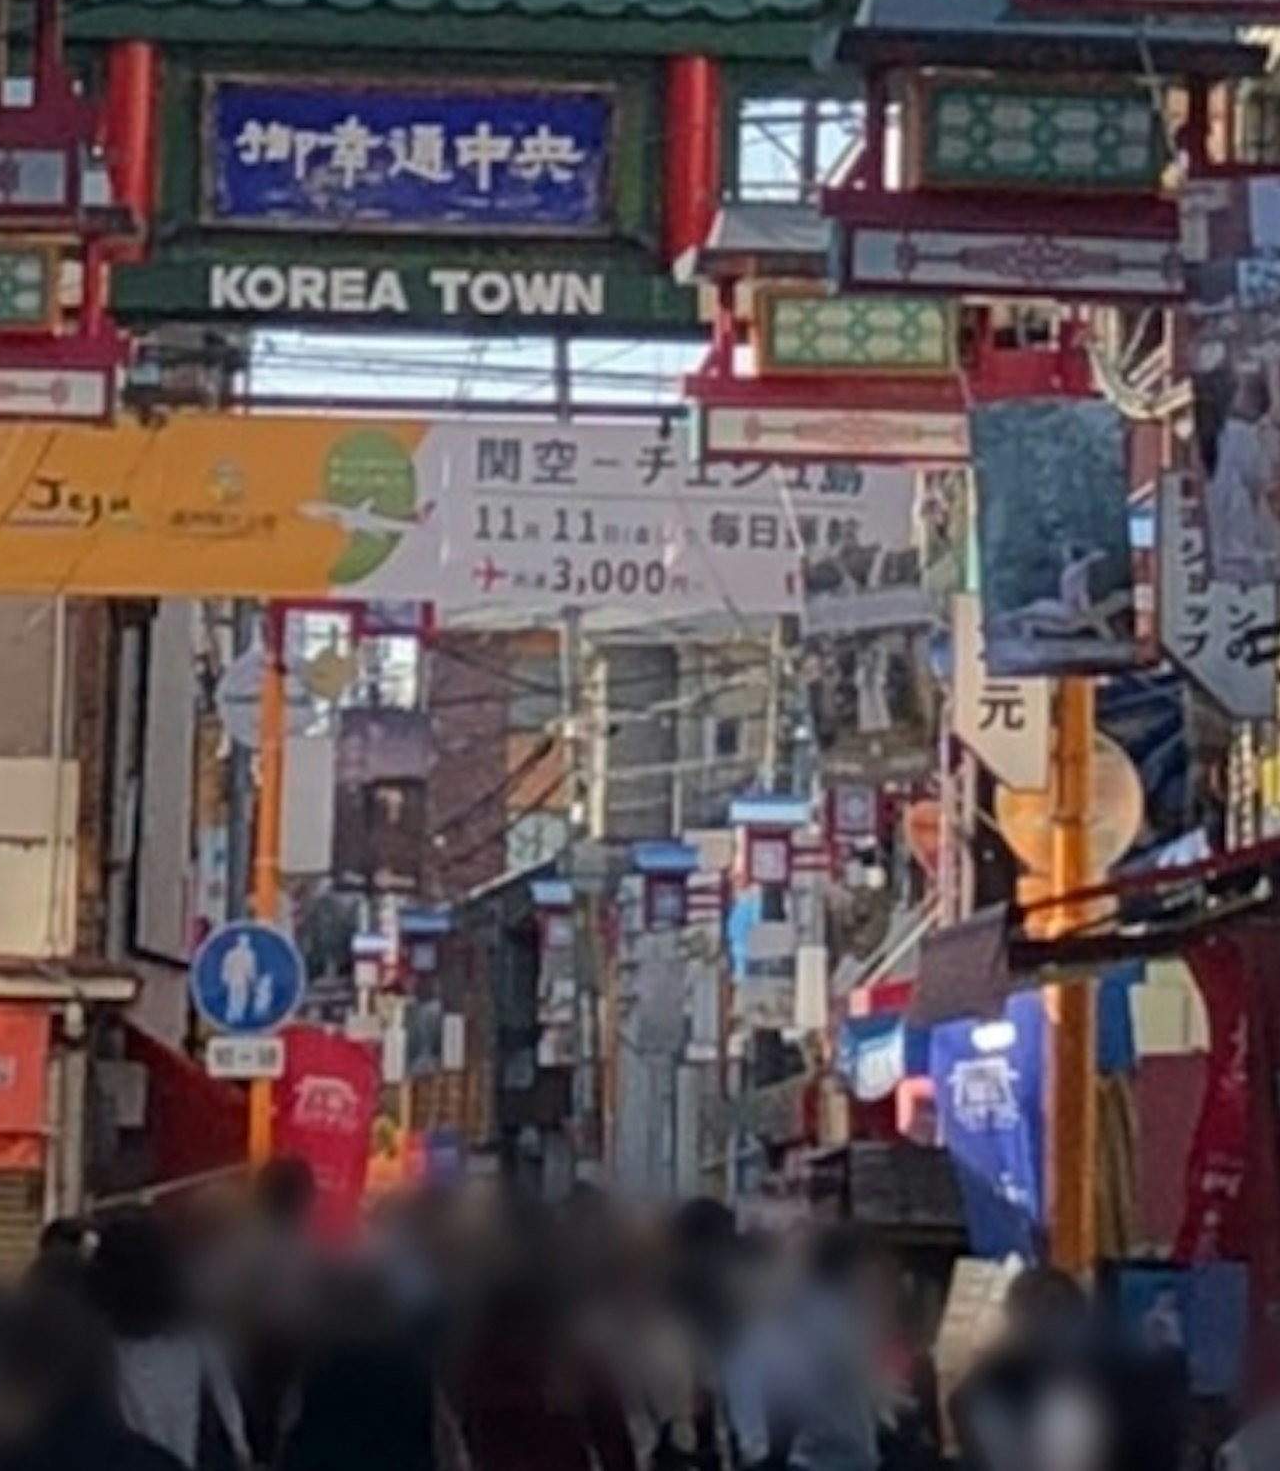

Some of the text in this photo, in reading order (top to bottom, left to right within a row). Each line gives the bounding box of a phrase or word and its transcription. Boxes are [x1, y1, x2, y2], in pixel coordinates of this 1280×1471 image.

[233, 113, 586, 192] 御幸通中央
[209, 265, 605, 315] KOREA TOWN
